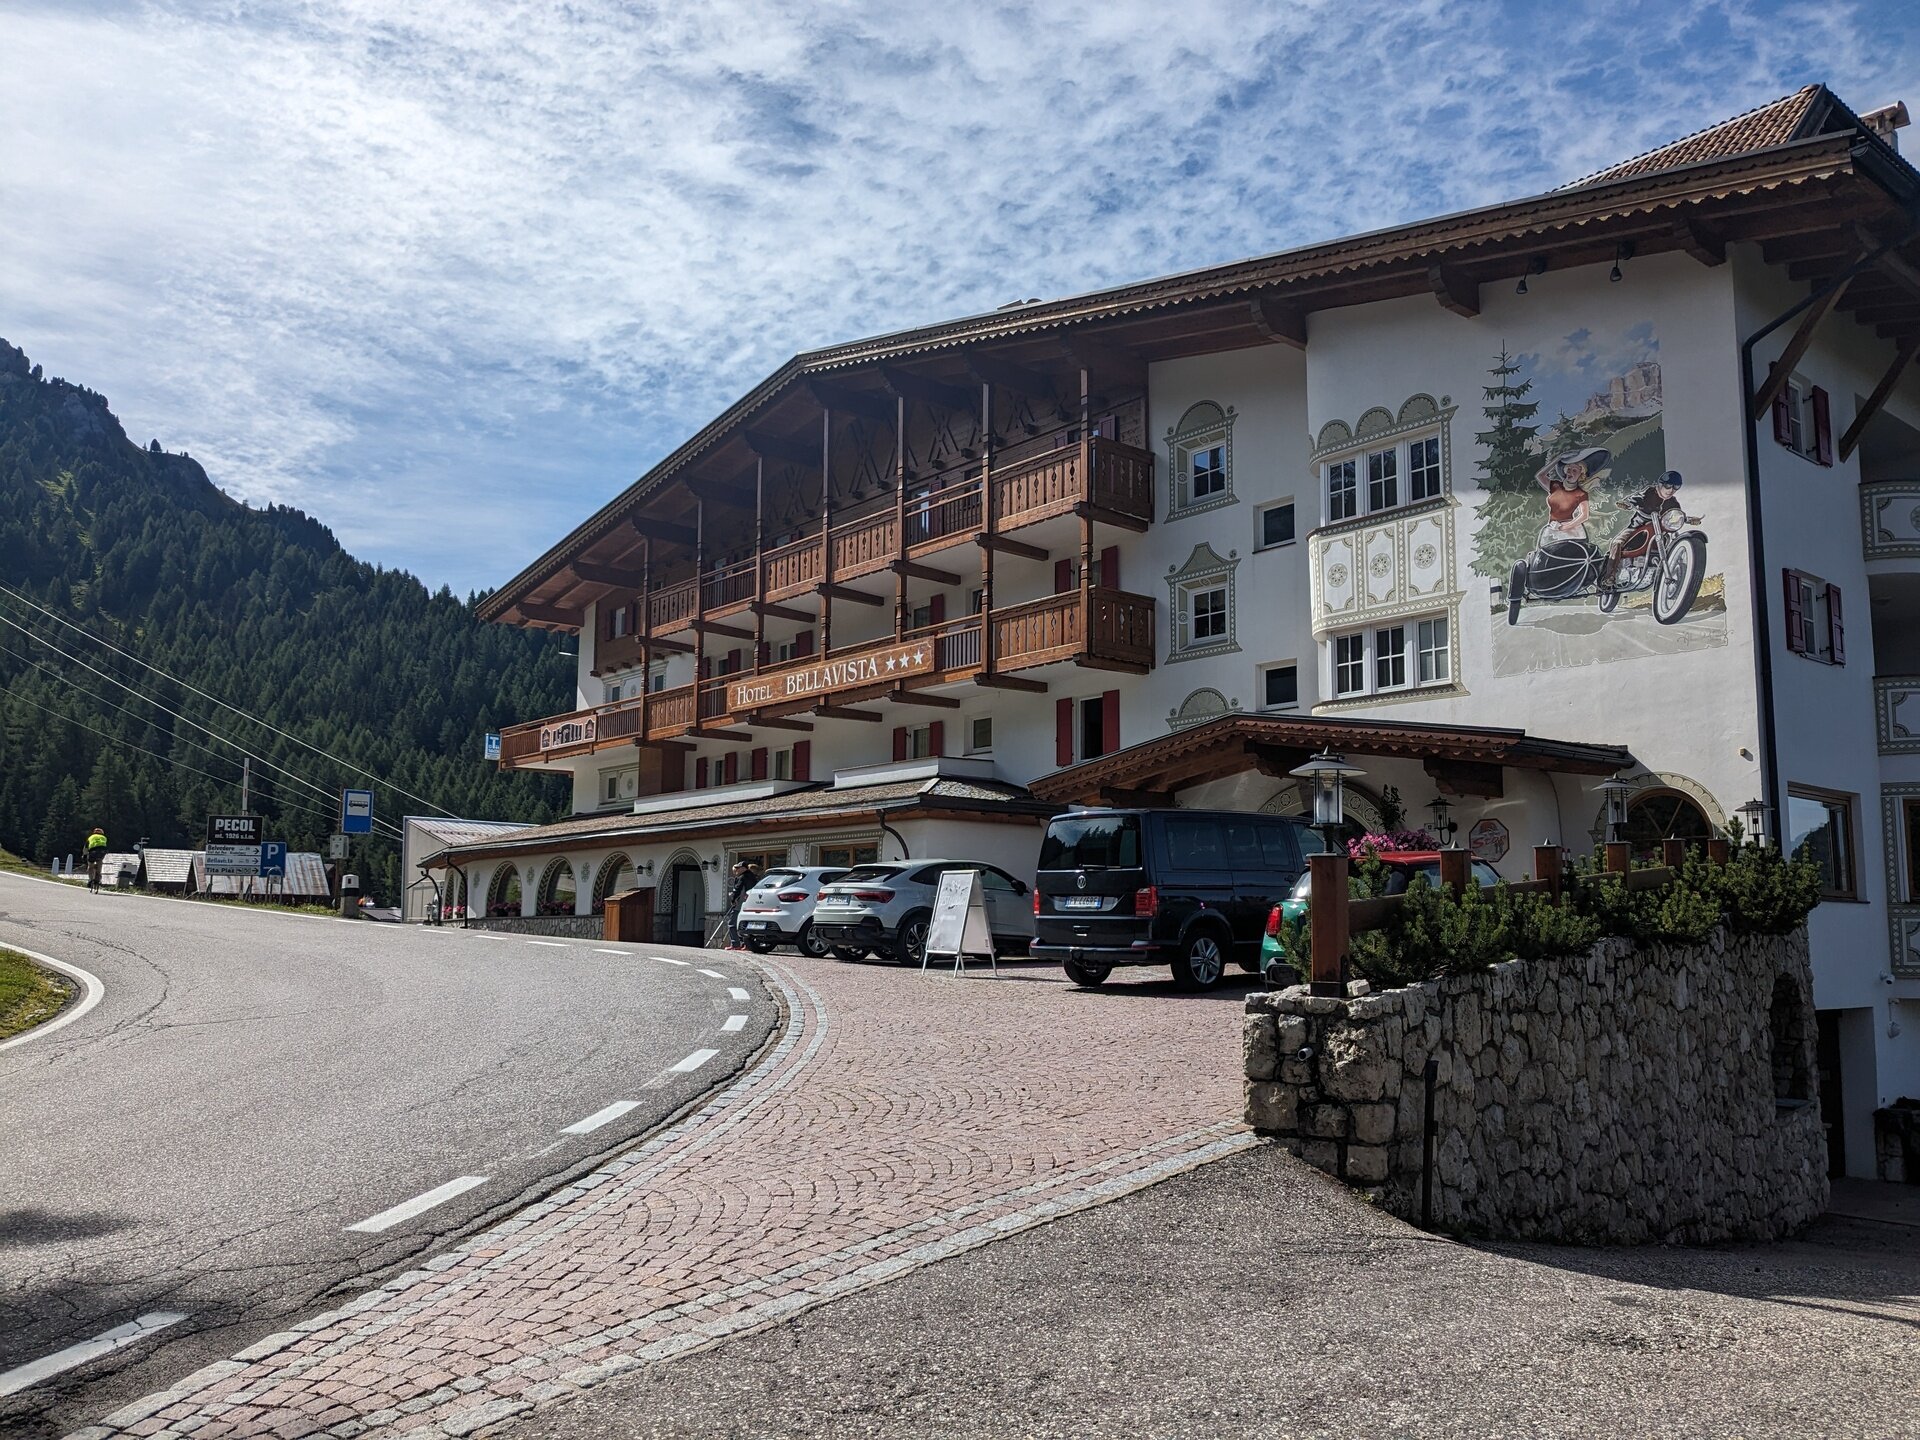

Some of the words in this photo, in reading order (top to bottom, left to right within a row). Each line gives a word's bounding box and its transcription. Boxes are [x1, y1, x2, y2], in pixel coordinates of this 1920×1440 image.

[786, 657, 878, 695] BELLAVISTA
[215, 818, 256, 832] PECOL
[267, 844, 279, 859] P
